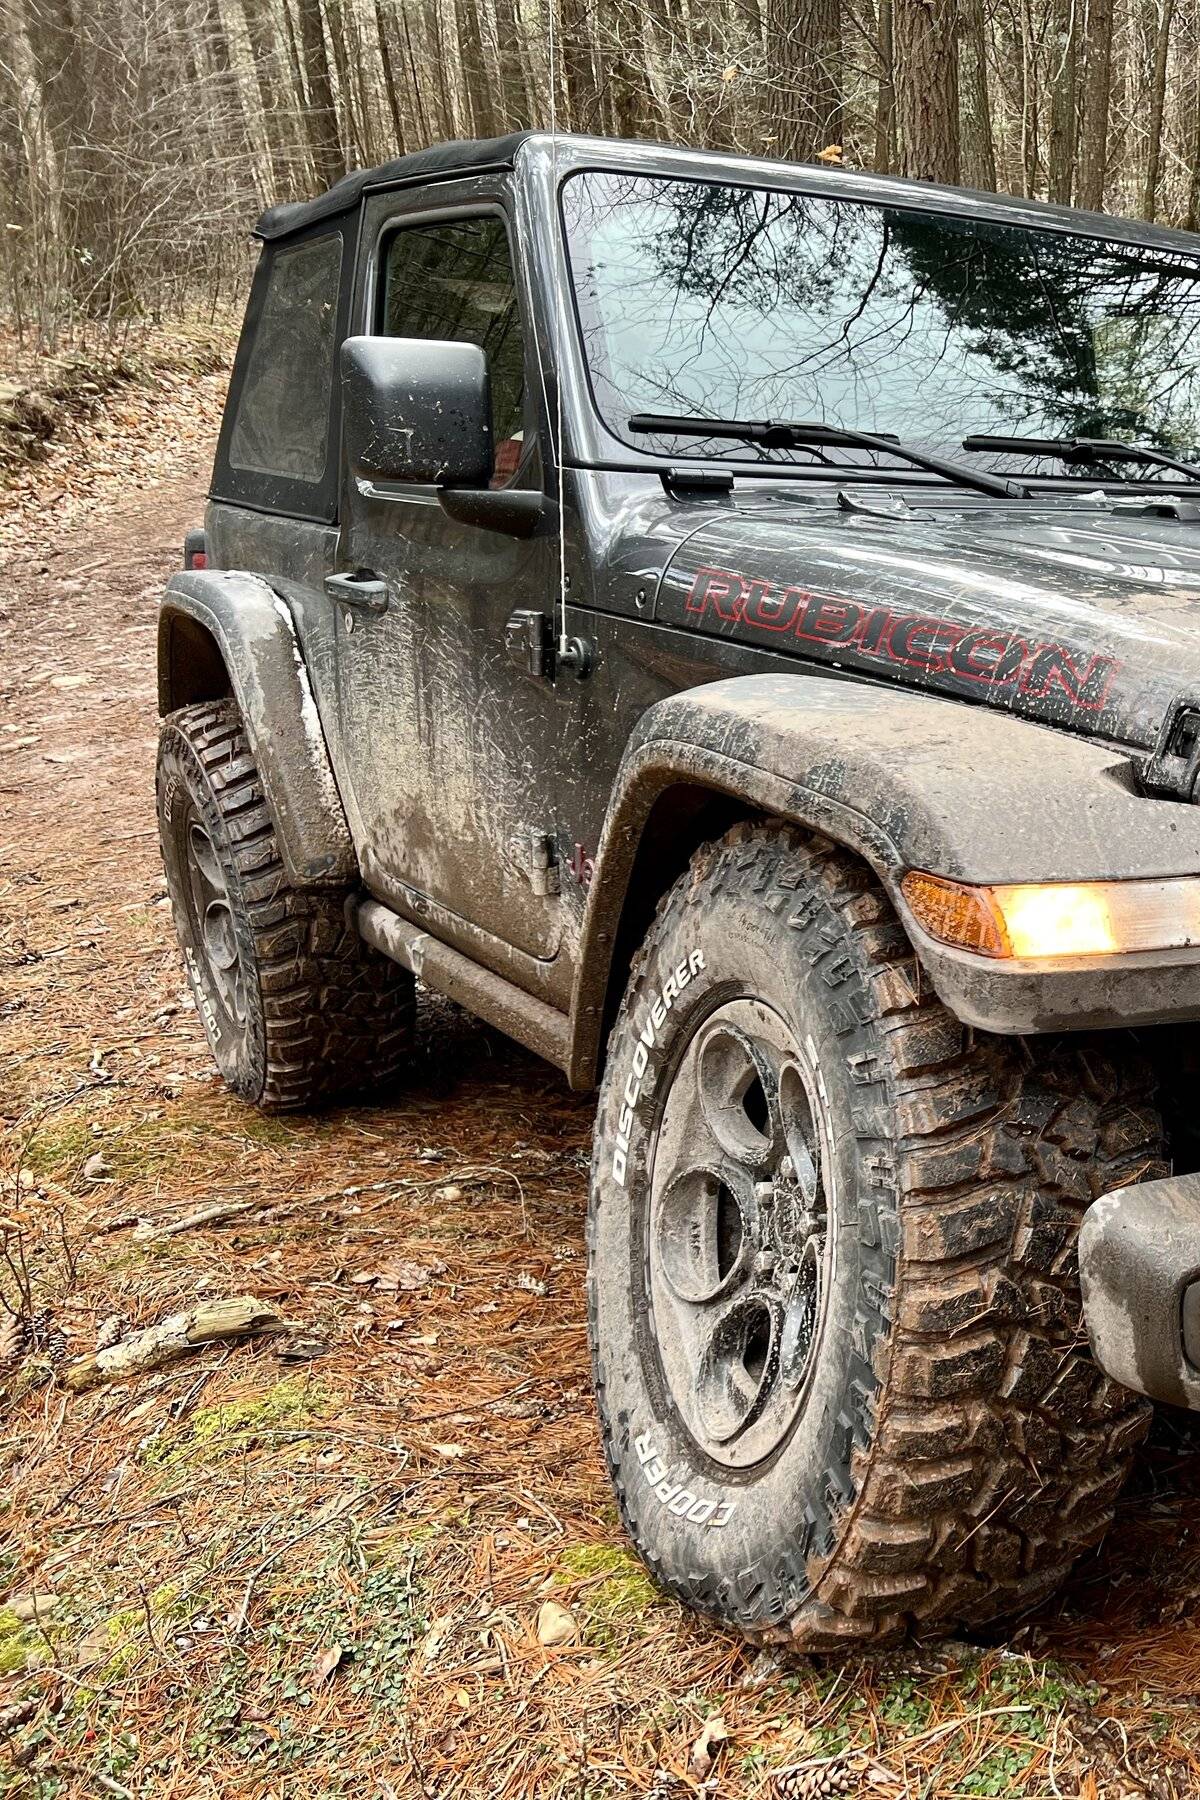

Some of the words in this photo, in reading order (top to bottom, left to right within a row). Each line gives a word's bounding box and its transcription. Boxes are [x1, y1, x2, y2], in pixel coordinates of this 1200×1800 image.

[688, 568, 1124, 710] RUBICON
[185, 947, 222, 1042] COOPER
[612, 948, 707, 1187] DISCOVERER
[634, 1429, 736, 1527] COOPER
